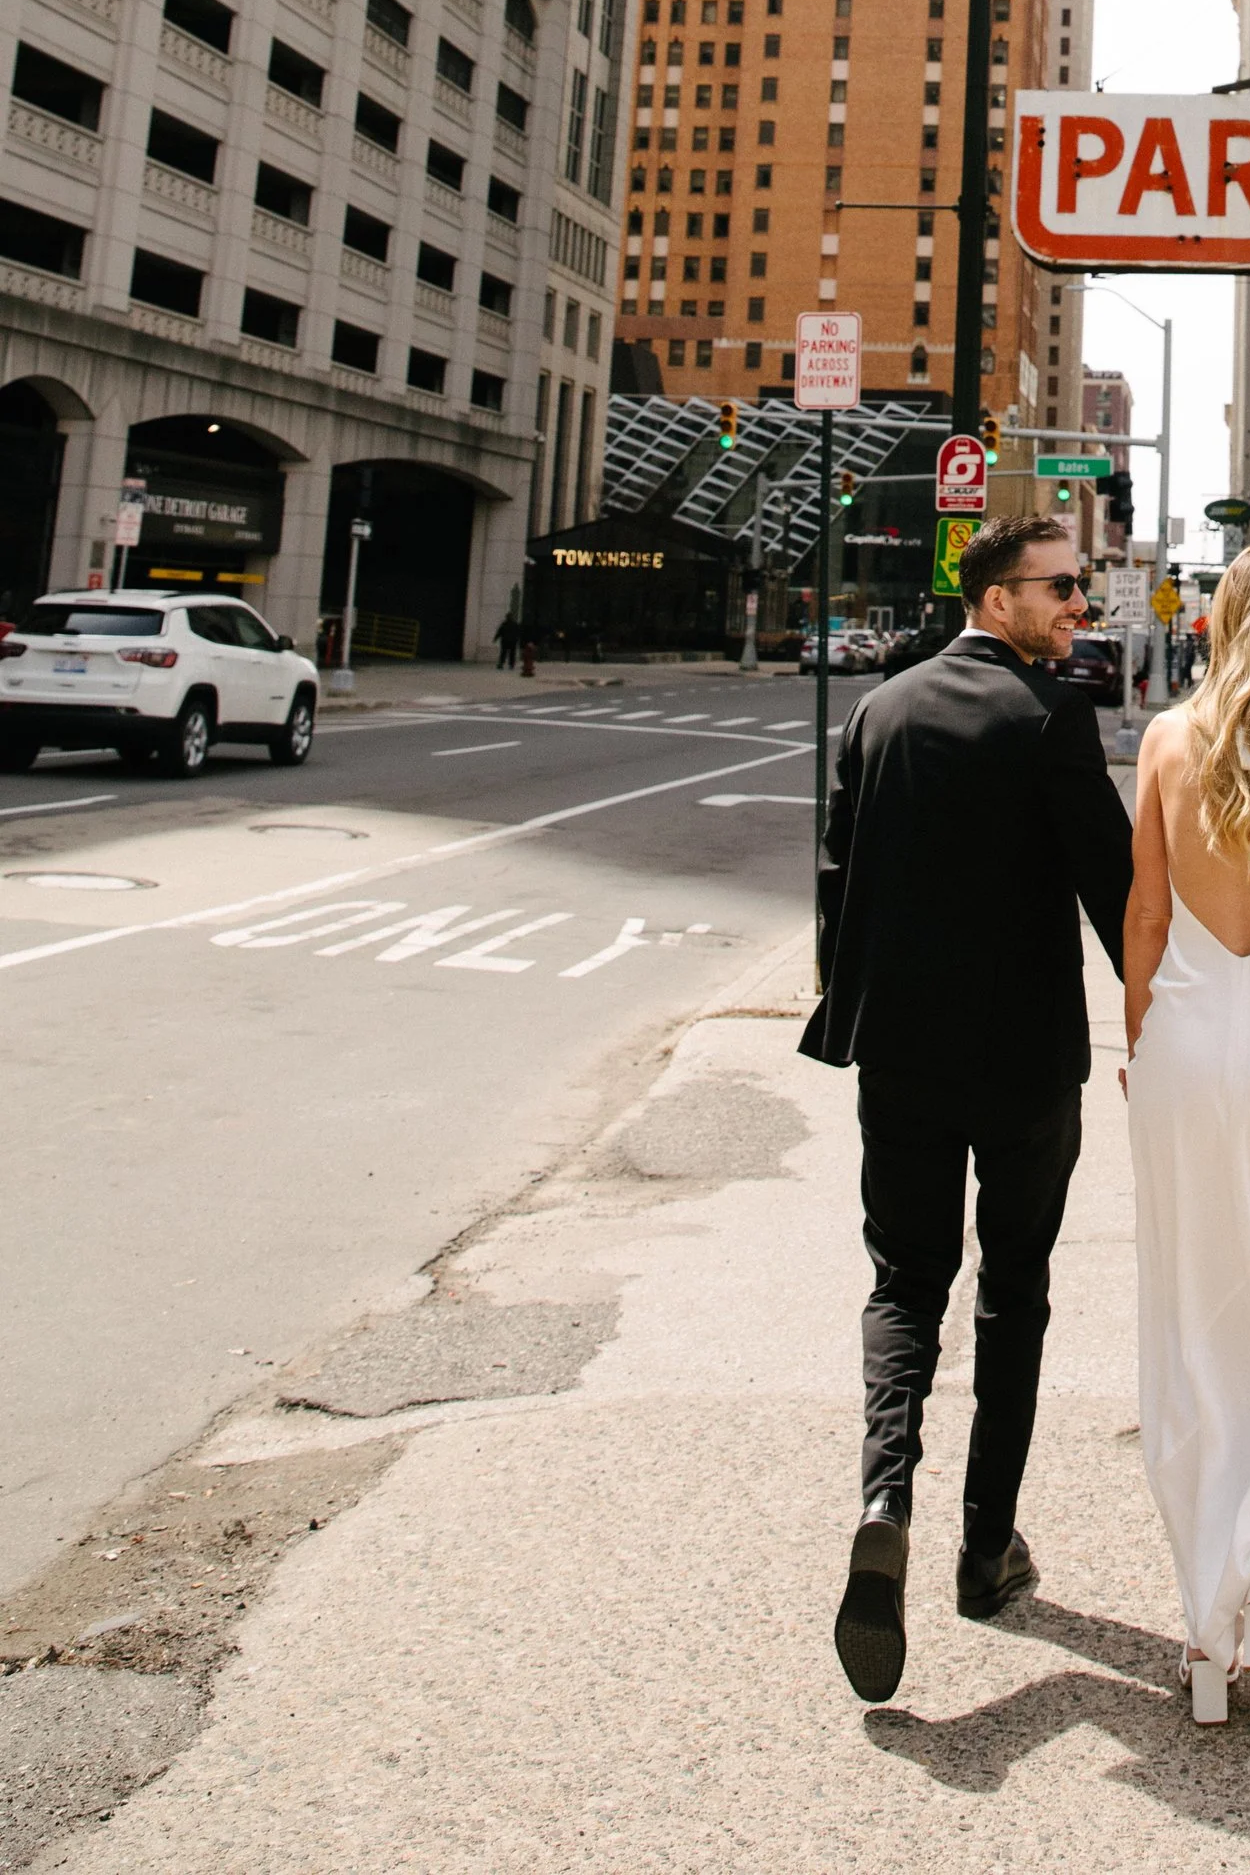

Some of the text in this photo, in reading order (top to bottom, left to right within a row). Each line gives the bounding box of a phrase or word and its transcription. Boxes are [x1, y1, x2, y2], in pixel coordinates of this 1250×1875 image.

[821, 322, 838, 336] NO
[800, 340, 856, 354] PARKING
[808, 358, 849, 370] ACROSS
[801, 375, 854, 388] DRIVEWAY
[1057, 461, 1090, 473] Bates
[208, 501, 248, 524] GARAGE
[552, 549, 664, 568] TOWNHOUSE
[1116, 574, 1141, 584] STOP
[1115, 587, 1140, 597] HERE
[209, 900, 712, 978] ONLY
